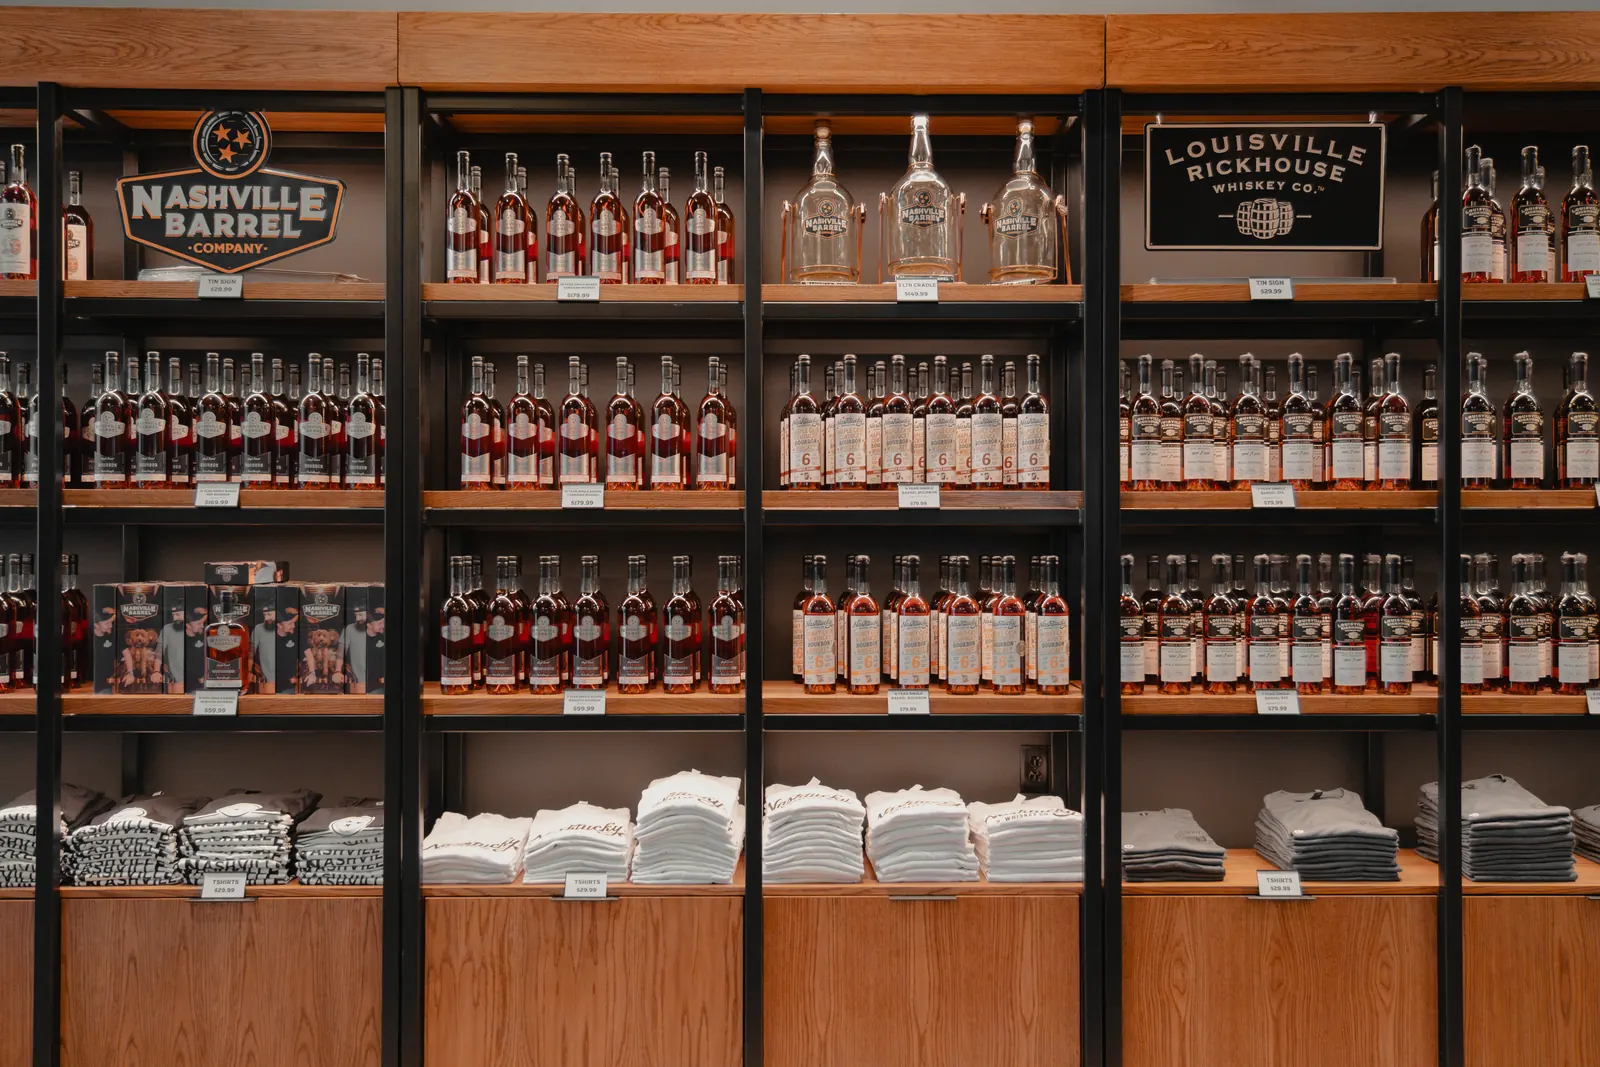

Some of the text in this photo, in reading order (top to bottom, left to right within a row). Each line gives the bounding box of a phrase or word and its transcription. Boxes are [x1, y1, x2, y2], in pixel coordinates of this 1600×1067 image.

[1165, 133, 1367, 166] LOUISVILLE
[1186, 157, 1347, 183] RICKHOUSE
[1213, 180, 1286, 194] WHISKEY
[131, 184, 328, 221] NASHVILLE
[165, 213, 302, 239] BARREL
[802, 453, 811, 465] 6
[846, 453, 855, 465] 6
[893, 453, 902, 465] 6
[939, 453, 947, 465] 6
[982, 453, 991, 465] 6
[1004, 456, 1013, 468] 6
[1029, 453, 1038, 465] 6
[815, 656, 824, 668] 6
[864, 656, 873, 668] 6
[911, 656, 920, 668] 6
[960, 656, 969, 668] 6
[997, 656, 1006, 668] 6
[1049, 656, 1058, 668] 6
